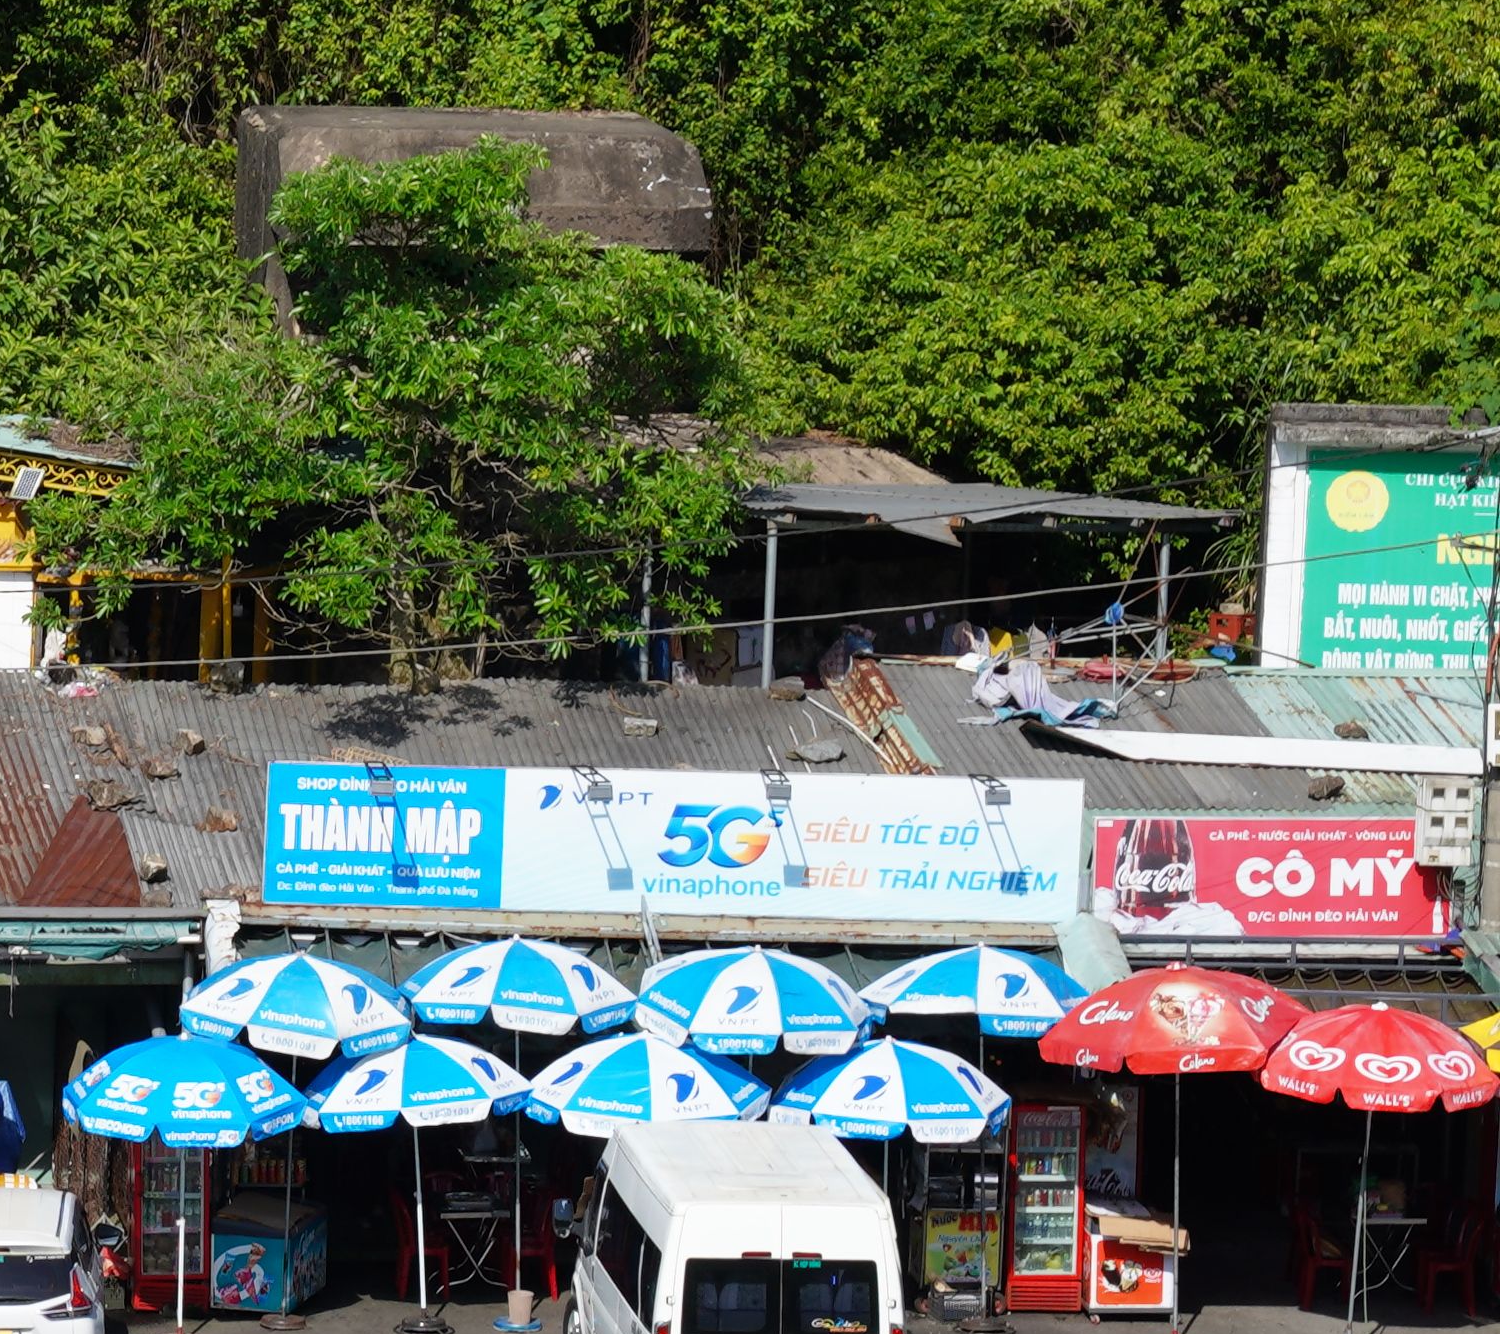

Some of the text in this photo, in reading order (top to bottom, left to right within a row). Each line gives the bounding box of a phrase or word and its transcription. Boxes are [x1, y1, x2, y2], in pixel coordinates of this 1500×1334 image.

[1405, 473, 1434, 487] CHI
[1434, 493, 1467, 509] HẠT
[1338, 582, 1366, 609] MỌI
[1370, 580, 1410, 606] HÀNH
[1414, 585, 1427, 606] VI
[1359, 613, 1401, 642] NUÔI,
[1406, 612, 1450, 643] NHỐT,
[297, 777, 337, 792] SHOP
[410, 777, 436, 793] HẢI
[439, 777, 467, 794] VÂN
[279, 798, 483, 864] THÀNH MẬP
[803, 815, 980, 851] SIÊU TỐC ĐỘ
[1209, 828, 1411, 842] CÀ PHÊ NƯỚC GIẢI KHÁT VÒNG LƯU
[276, 860, 294, 875] CÀ
[295, 860, 319, 875] PHÊ
[329, 861, 352, 876] GIẢI
[354, 861, 386, 877] KHÁT
[425, 865, 450, 878] LƯU
[451, 865, 481, 880] NIỆM
[803, 861, 1058, 896] SIÊU TRẢI NGHIỆM
[1116, 863, 1196, 893] Coca-Cola
[1236, 849, 1414, 898] CÔ MỸ
[643, 873, 780, 898] vinaphone
[1278, 906, 1311, 923] ĐỈNH
[1315, 906, 1341, 923] ĐÈO
[1345, 906, 1368, 923] HẢI
[1371, 907, 1399, 923] VÂN
[501, 989, 564, 1007] vinaphone
[259, 1009, 327, 1031] vinaphone
[1079, 1000, 1135, 1025] Celano
[717, 1018, 759, 1027] VNPT
[409, 1086, 476, 1102] vinaphone
[1278, 1075, 1316, 1096] WALL'S
[578, 1097, 644, 1115] vinaphone
[1363, 1092, 1411, 1108] WALL'S
[171, 1109, 232, 1122] vinaphone
[166, 1130, 216, 1143] vinaphone
